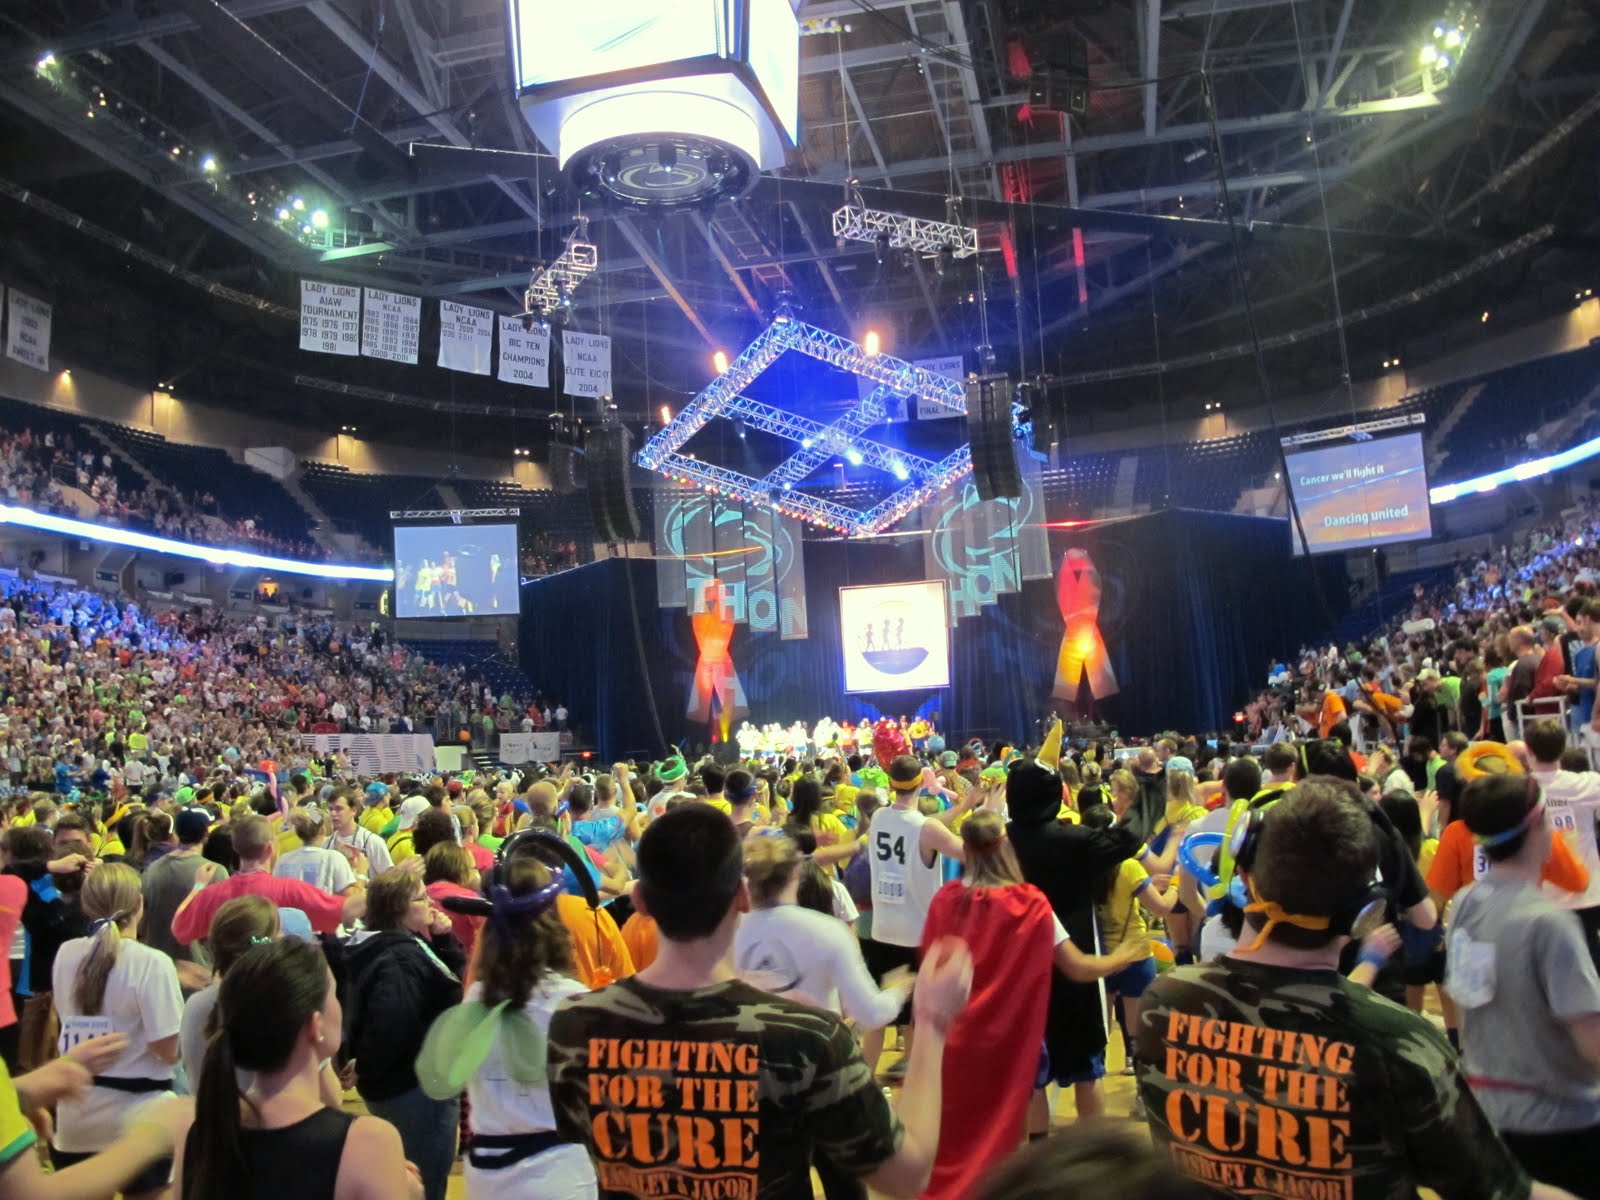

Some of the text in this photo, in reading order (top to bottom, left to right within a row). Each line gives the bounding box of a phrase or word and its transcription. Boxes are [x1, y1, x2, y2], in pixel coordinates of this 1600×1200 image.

[305, 282, 356, 297] LADY LIONS
[319, 296, 342, 307] AIAW
[368, 290, 417, 307] LADY LIONS
[302, 304, 358, 320] TOURNAMENT
[382, 304, 402, 313] NCAA
[443, 302, 491, 319] LADY LIONS
[302, 316, 358, 331] 1975 1976 1977
[455, 315, 477, 326] NCAA
[502, 321, 522, 333] LADY
[302, 327, 317, 338] 1978
[321, 330, 338, 341] 1979
[322, 342, 337, 351] 1981
[508, 338, 540, 351] BIG TEN
[565, 336, 609, 349] LADY LIONS
[370, 349, 408, 361] 2000 2001
[502, 352, 546, 367] CHAMPIONS
[577, 352, 598, 362] NCAA
[513, 369, 534, 380] 2004
[565, 366, 586, 377] ELITE
[578, 383, 599, 393] 2004
[1300, 464, 1384, 486] Cancer we'll fight it
[1324, 504, 1409, 527] Dancing united
[877, 831, 905, 865] 54
[1167, 1010, 1356, 1075] FIGHTING
[588, 1038, 760, 1075] FIGHTING
[1166, 1047, 1351, 1113] FOR THE
[588, 1073, 760, 1113] FOR THE
[1166, 1088, 1353, 1169] CURE
[592, 1110, 760, 1169] CURE
[693, 1178, 750, 1200] JACOB
[1254, 1166, 1268, 1188] &
[1275, 1173, 1342, 1200] JACOB
